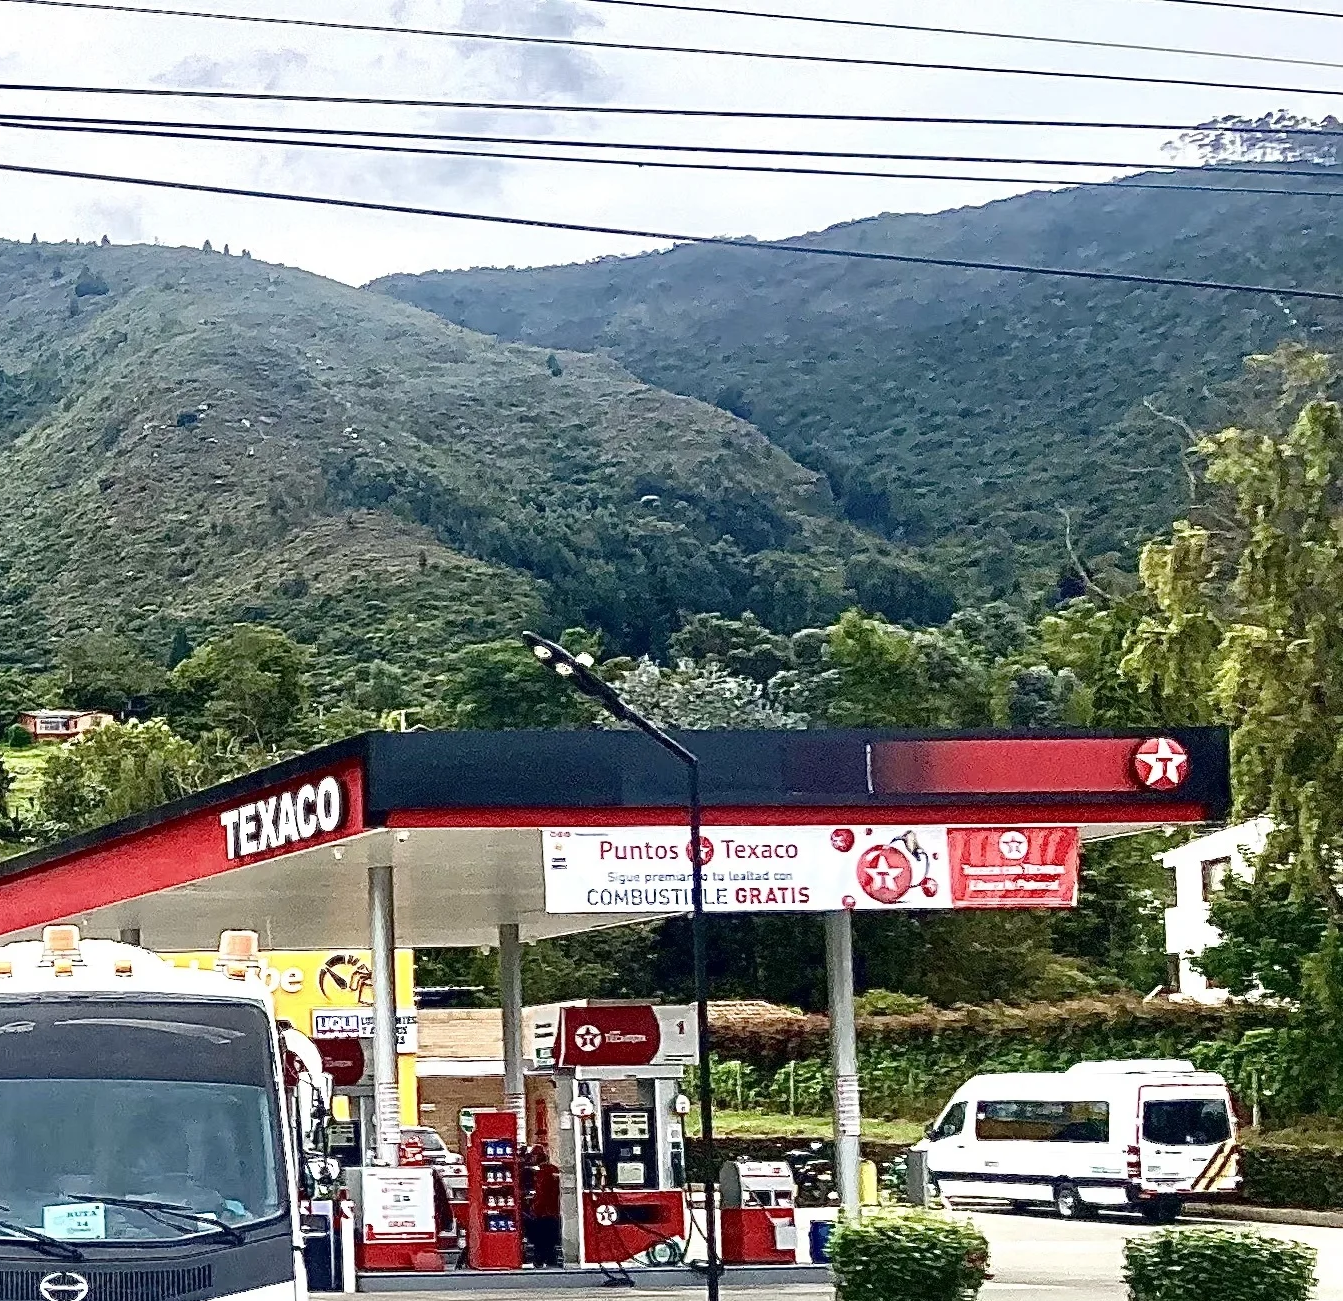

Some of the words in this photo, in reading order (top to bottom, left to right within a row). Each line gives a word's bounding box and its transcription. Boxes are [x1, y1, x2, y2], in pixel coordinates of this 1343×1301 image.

[219, 775, 341, 860] TEXACO
[599, 841, 680, 860] Puntos
[721, 840, 799, 859] Texaco
[607, 871, 641, 885] Sigue
[645, 872, 708, 885] premiano
[729, 870, 769, 882] lealtad
[774, 872, 793, 882] con
[587, 887, 728, 906] COMBUSTILE
[735, 886, 811, 905] GRATIS
[676, 1020, 685, 1035] 1
